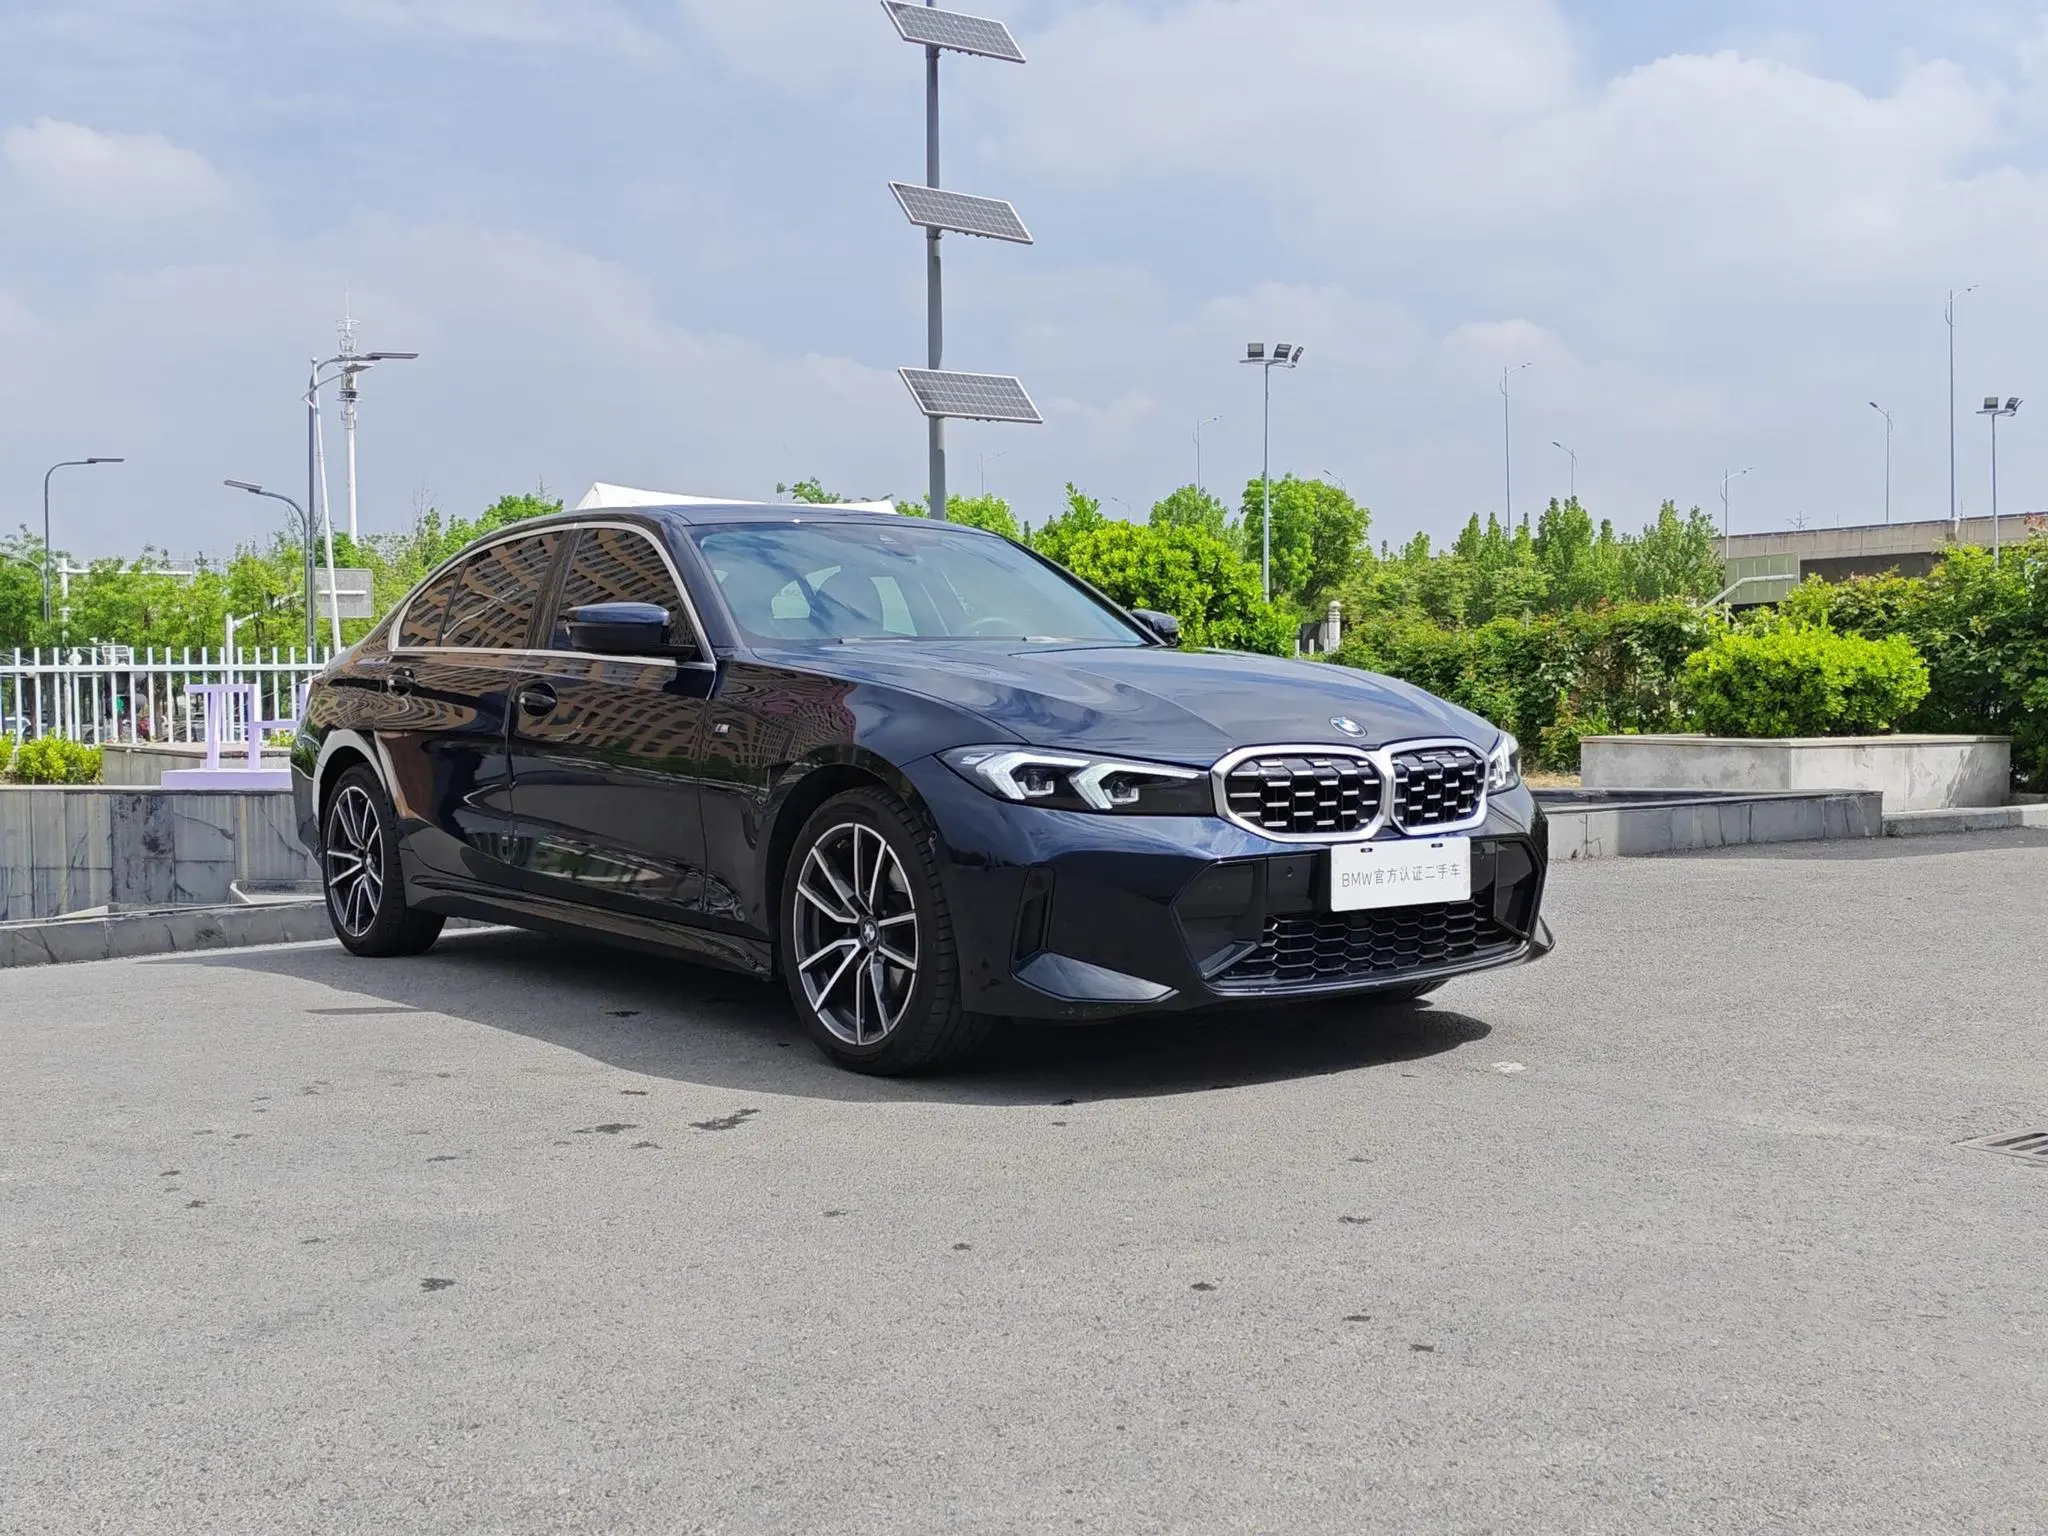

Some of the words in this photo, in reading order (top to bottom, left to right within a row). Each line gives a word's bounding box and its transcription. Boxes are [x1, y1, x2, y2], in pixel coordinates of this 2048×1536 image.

[1341, 863, 1461, 888] BMW官方认证二手车
